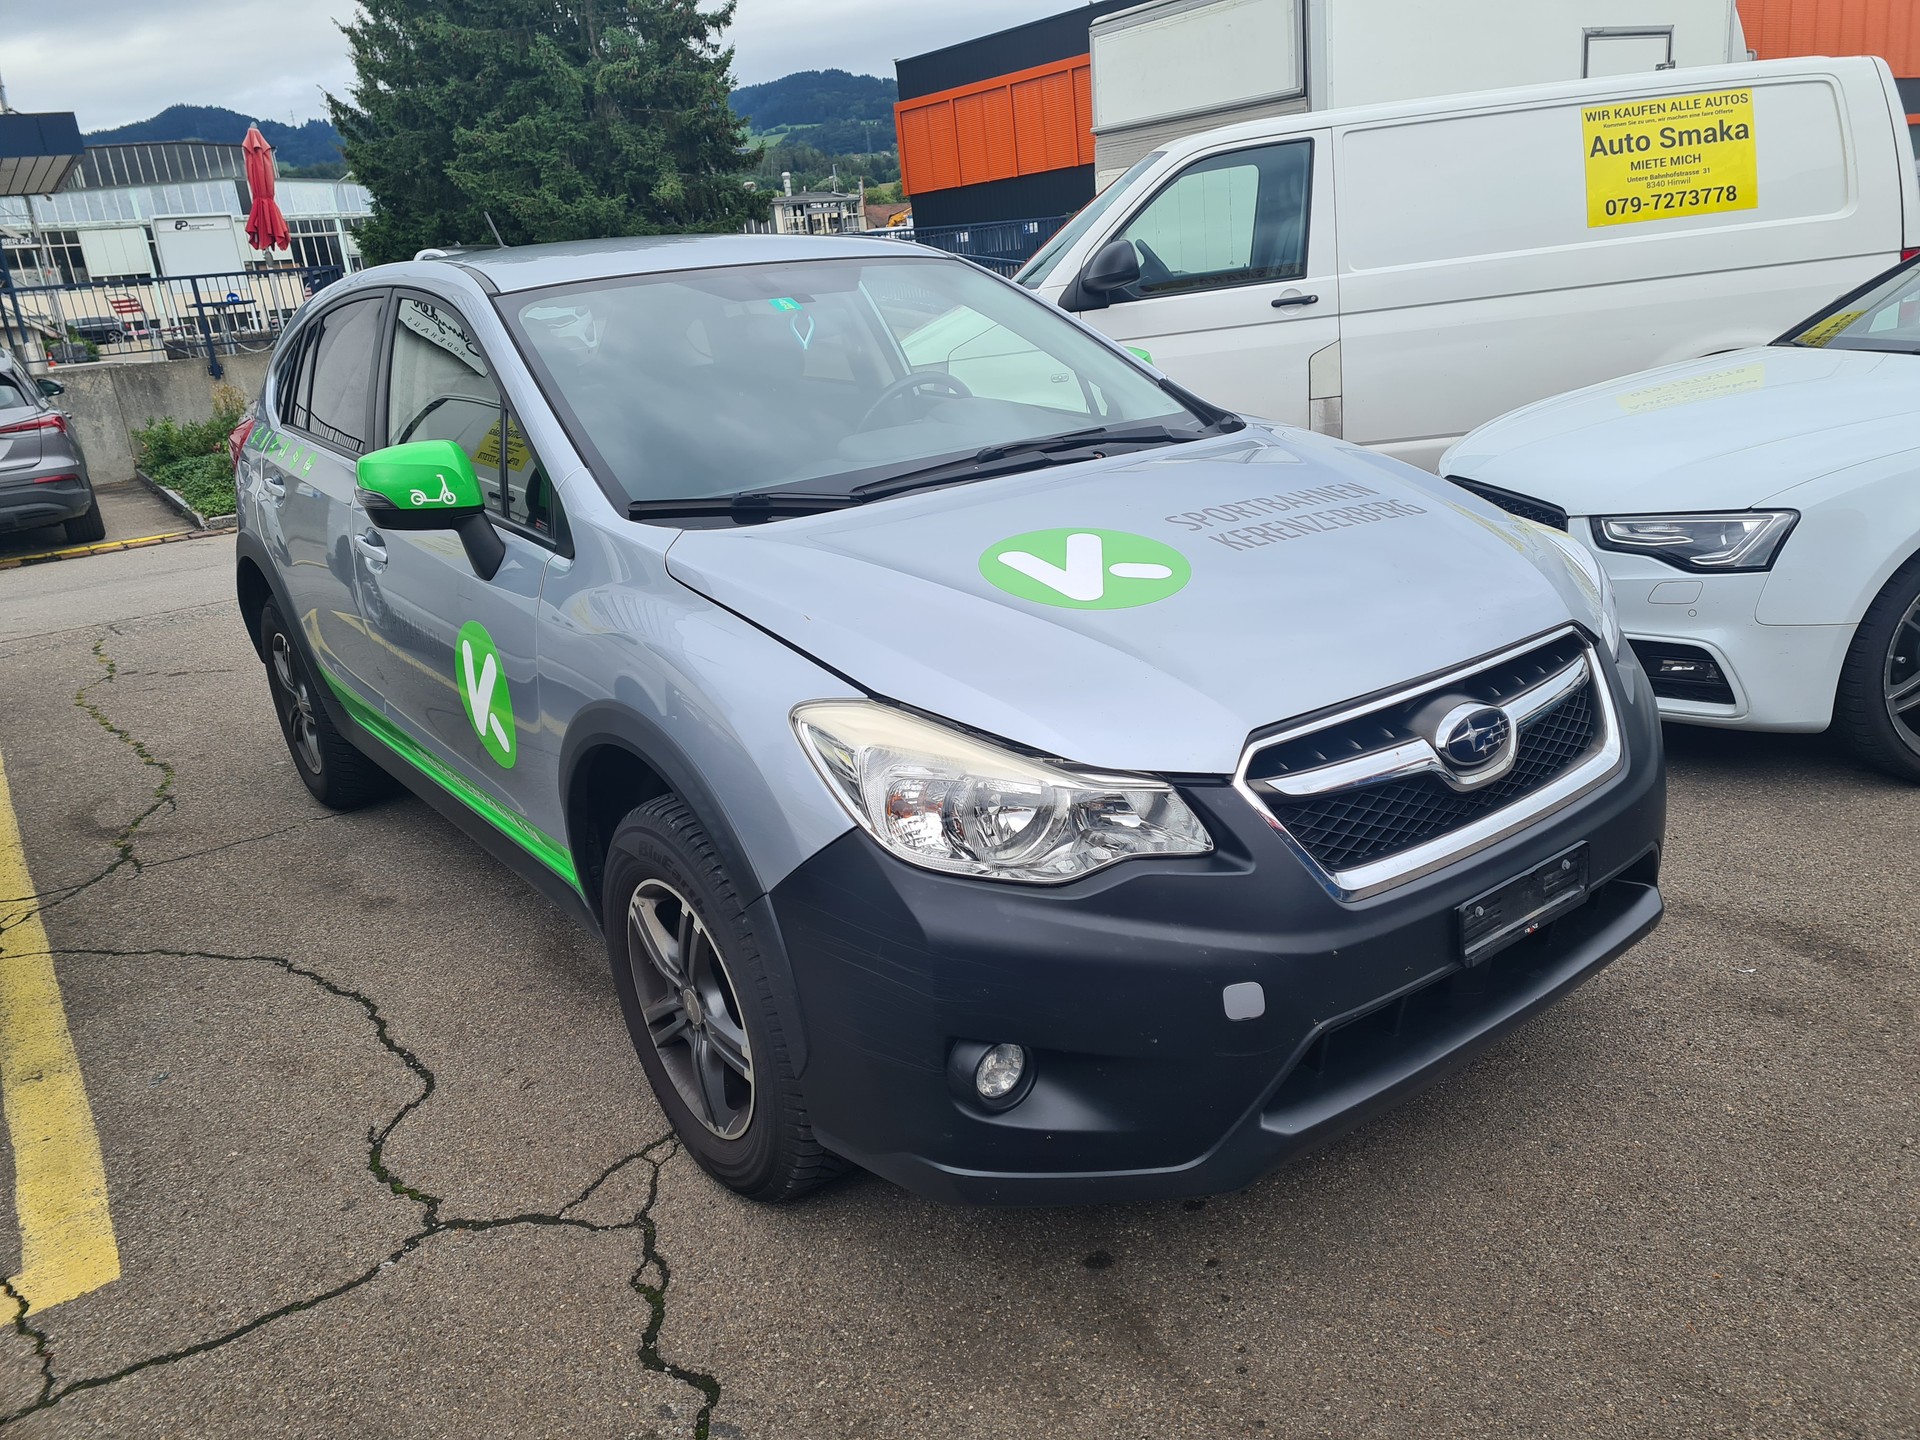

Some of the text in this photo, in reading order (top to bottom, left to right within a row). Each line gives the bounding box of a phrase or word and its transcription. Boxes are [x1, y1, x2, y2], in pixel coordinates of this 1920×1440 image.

[1585, 93, 1749, 122] WIR KAUFEN ALLE AUTOS
[1590, 120, 1749, 158] Auto Smaka
[1627, 174, 1648, 183] Untere
[1650, 169, 1700, 180] Bahnhofstrasse
[1630, 154, 1701, 171] MIETE MICH
[1646, 177, 1691, 189] 8340 Hinwil
[1605, 186, 1737, 216] 079-7273778
[1165, 482, 1381, 532] SPORTBAHNEN
[1208, 499, 1428, 551] KERENZERBERG
[638, 841, 705, 915] BluEarth
